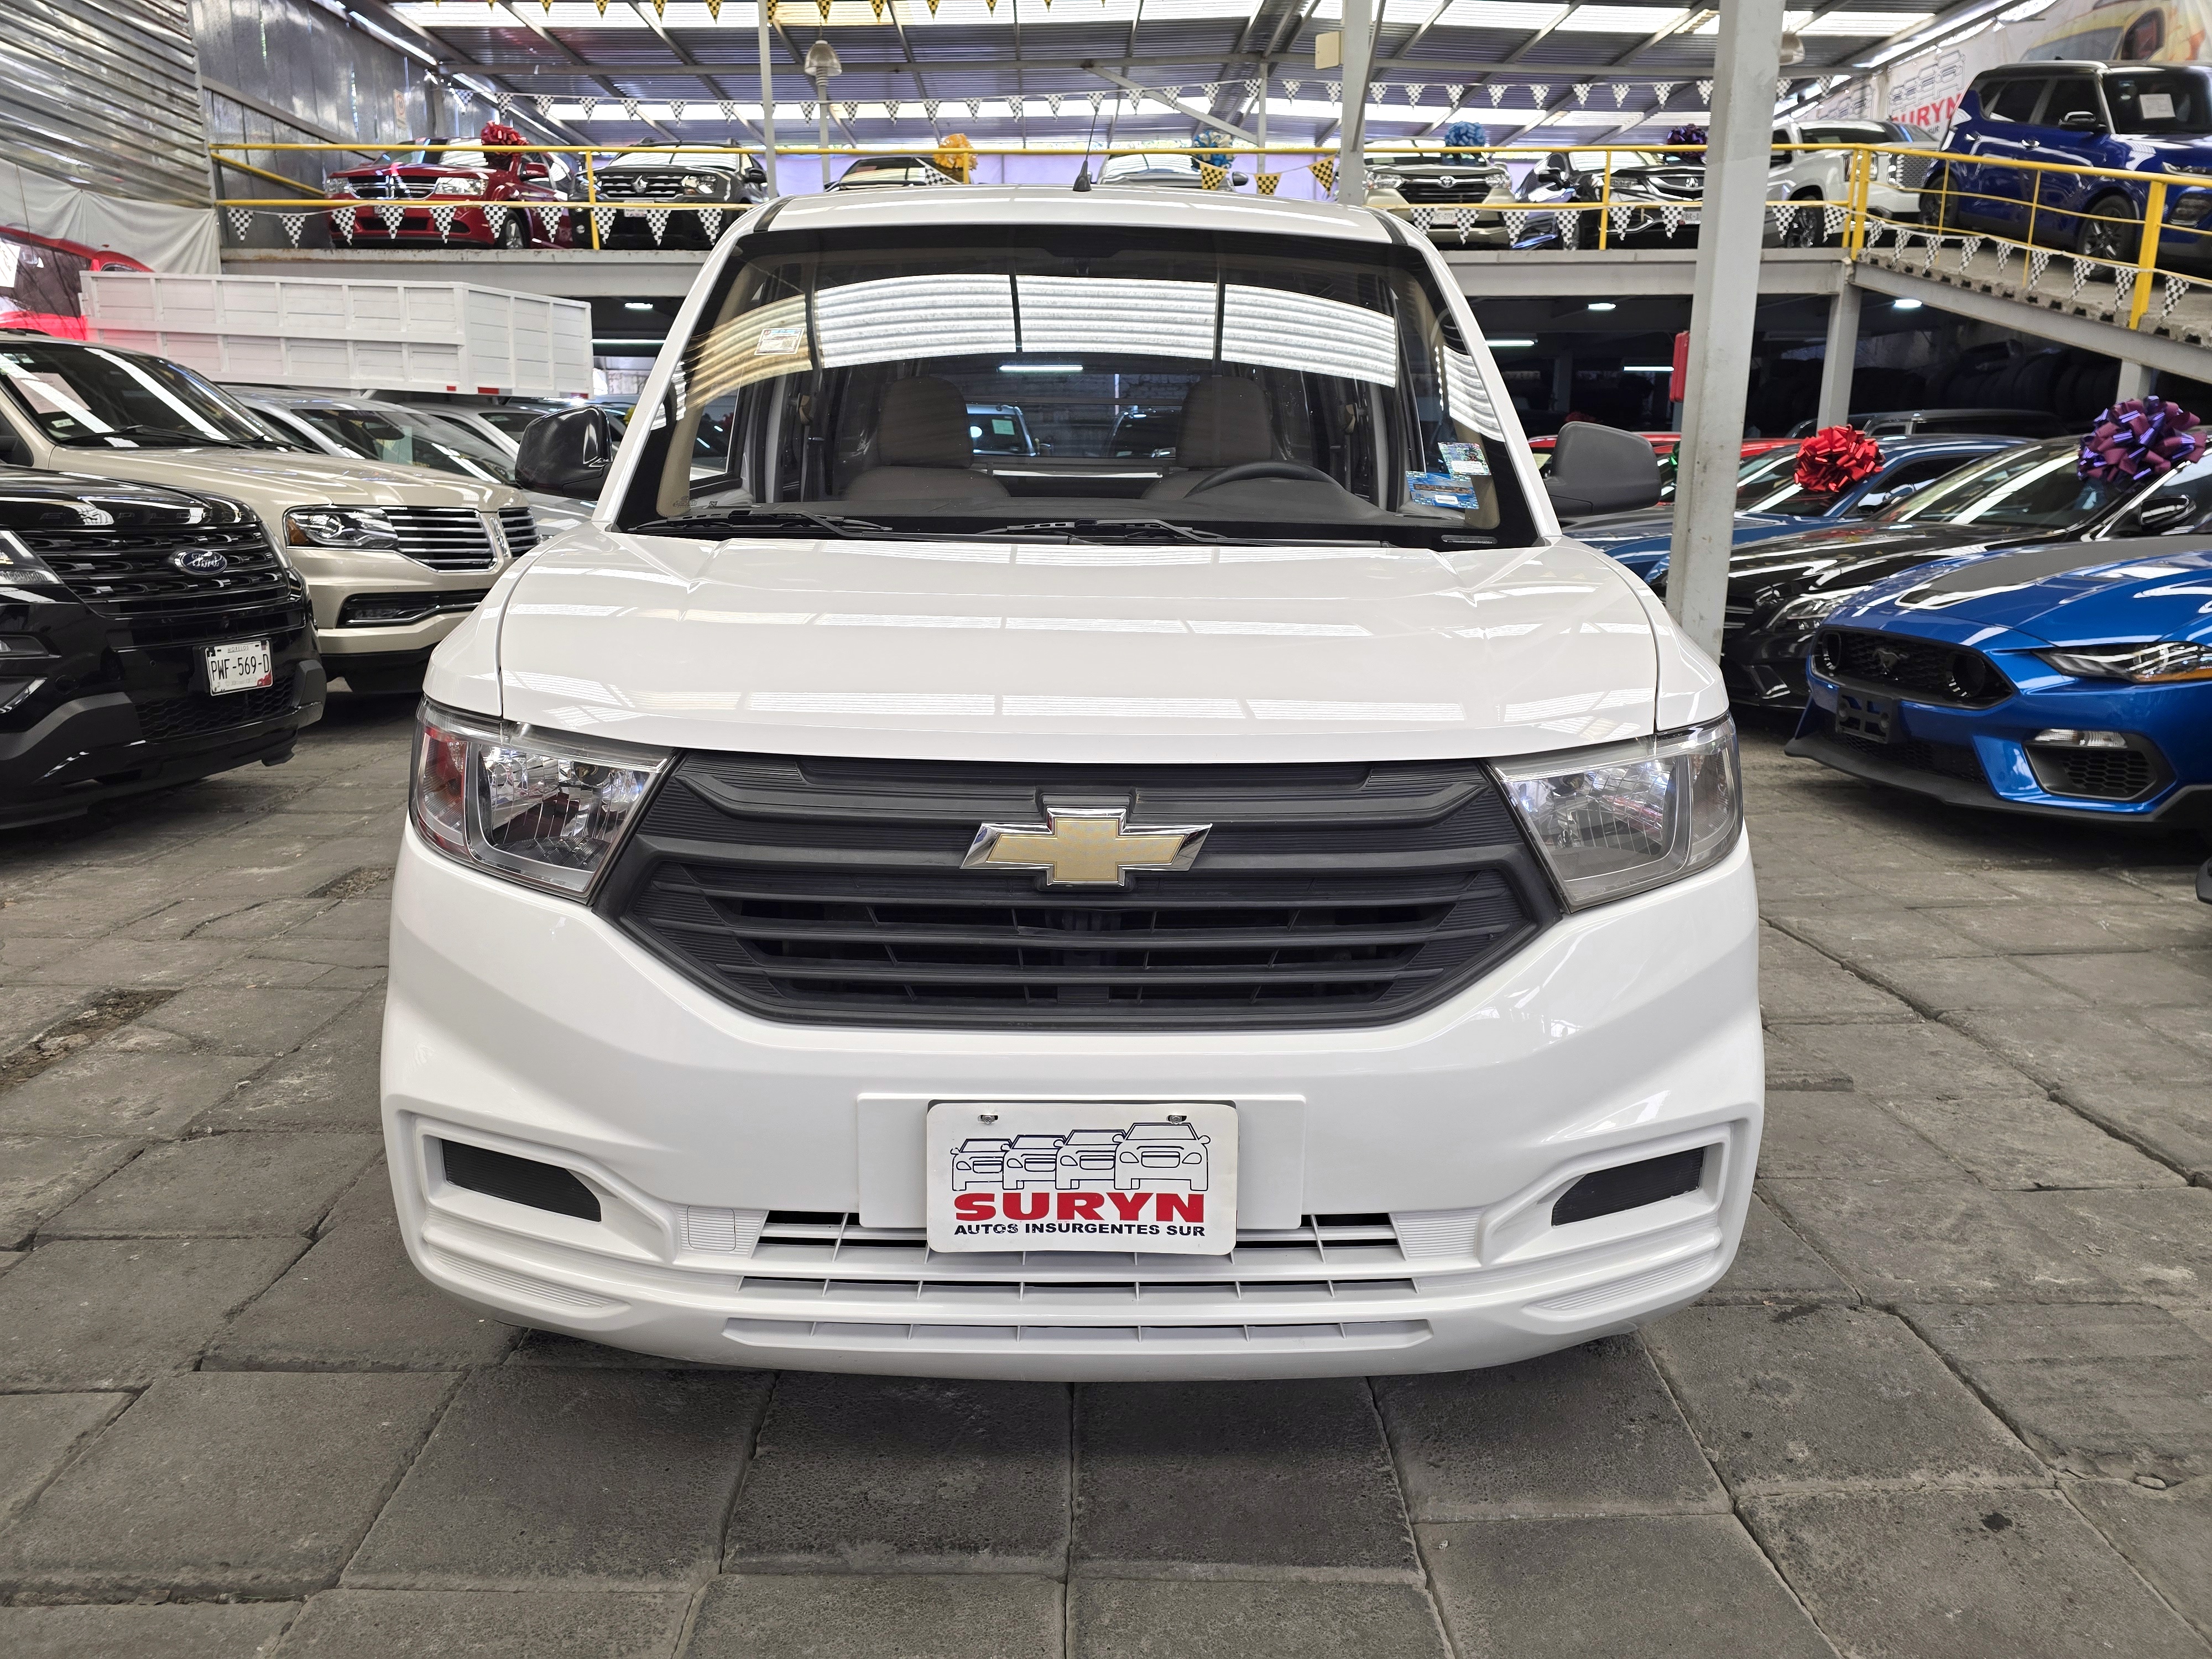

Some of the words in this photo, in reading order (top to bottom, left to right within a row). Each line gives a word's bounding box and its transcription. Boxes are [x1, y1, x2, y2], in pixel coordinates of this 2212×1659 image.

[187, 552, 222, 568] Ford
[211, 654, 269, 681] PWF-569-D
[954, 1192, 1204, 1223] SURYN
[954, 1223, 1019, 1235] AUTOS
[1025, 1223, 1160, 1235] INSURGENTES
[1166, 1225, 1206, 1237] SUR
